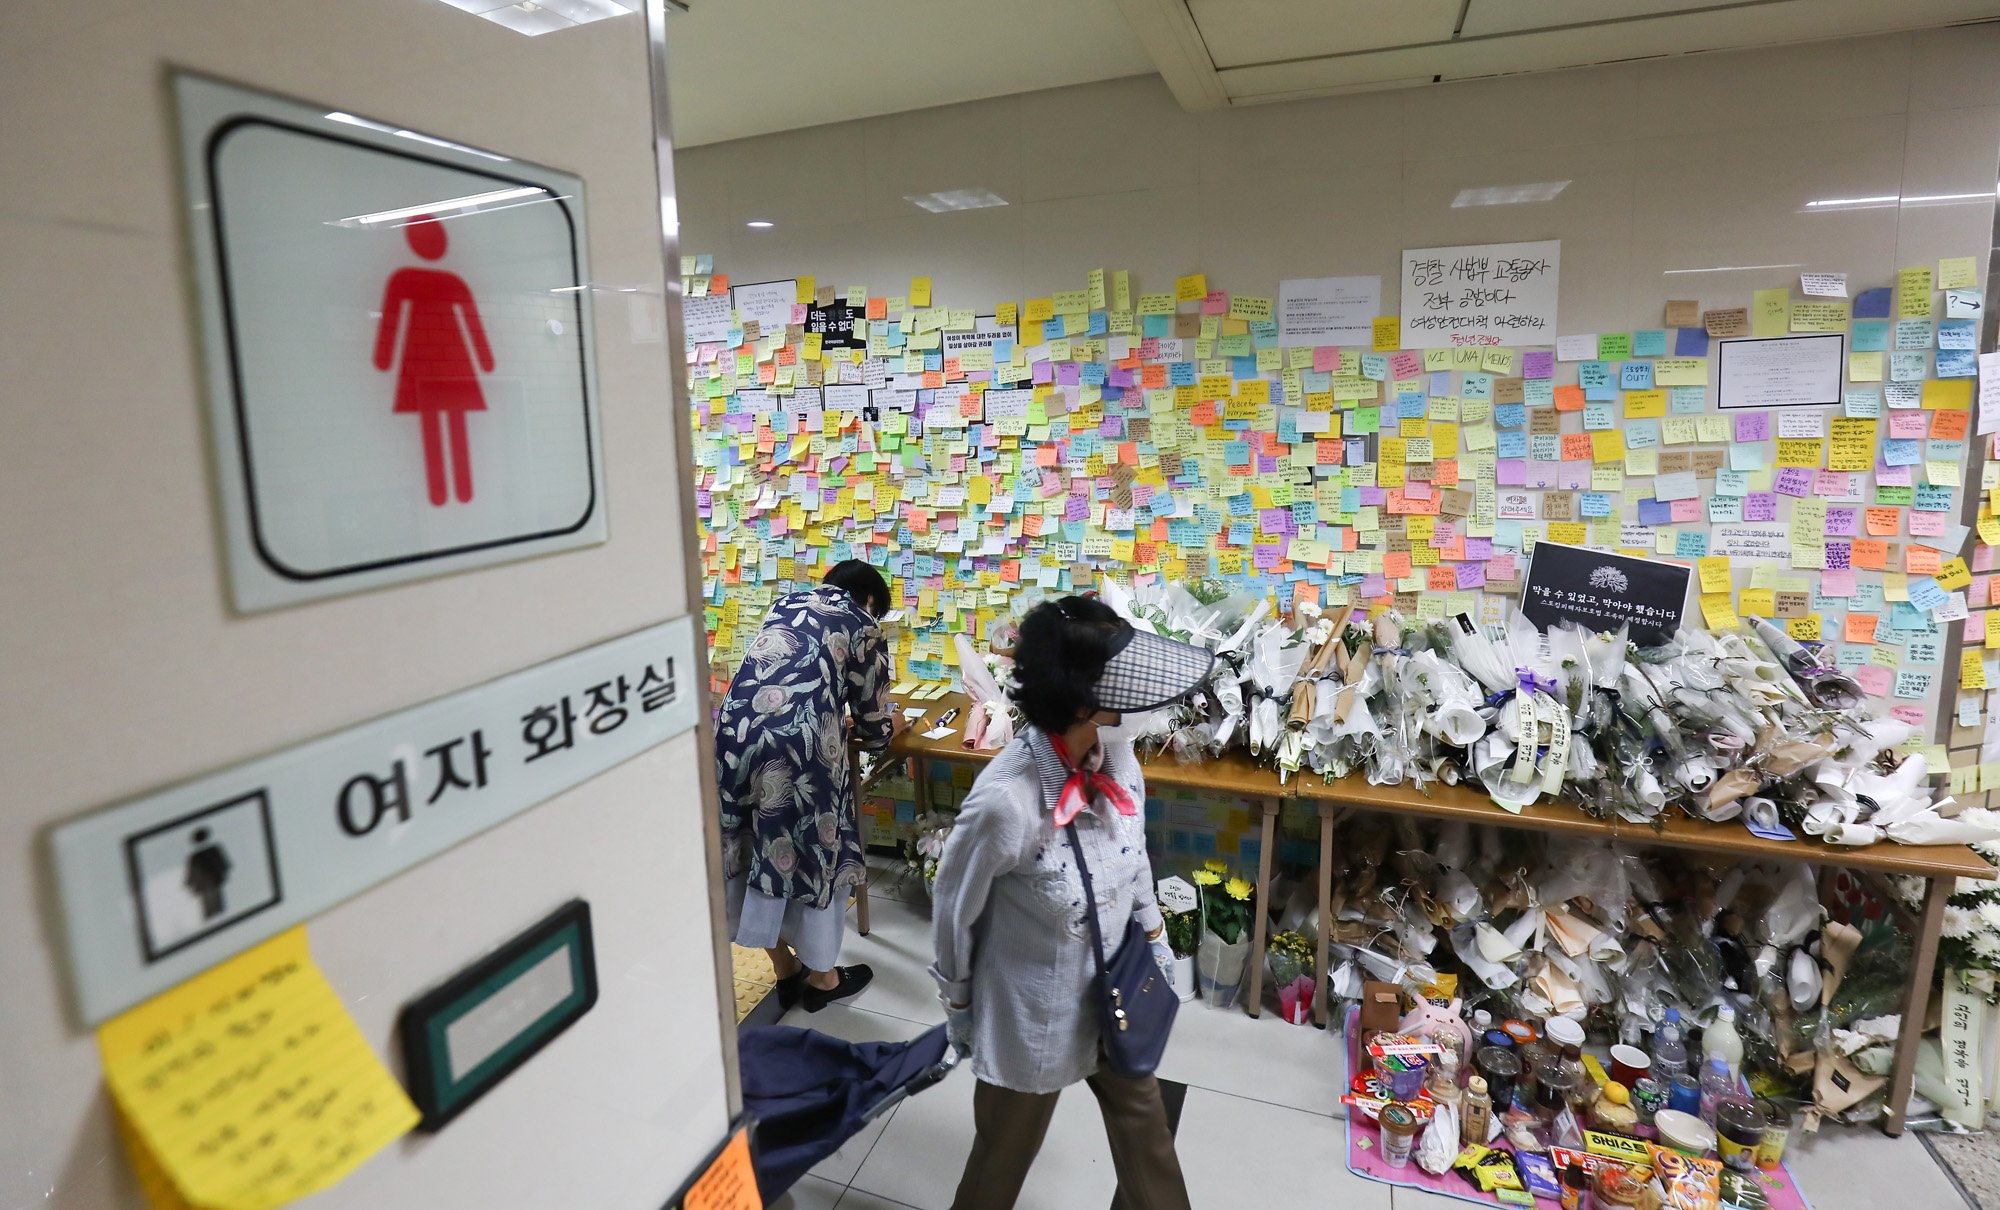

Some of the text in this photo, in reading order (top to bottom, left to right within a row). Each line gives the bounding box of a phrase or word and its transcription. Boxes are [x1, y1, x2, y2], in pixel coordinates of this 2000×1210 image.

[1410, 256, 1551, 286] 경찰 사법부 교통공사
[1424, 291, 1454, 310] 전부
[810, 310, 827, 321] 더는
[1411, 314, 1546, 330] 여성안전대책 마련하라
[811, 320, 855, 333] 잃을 수 없다
[963, 341, 977, 349] 살아갈
[987, 332, 1001, 340] 두려움
[1427, 350, 1512, 368] NI UNA MENOS
[1532, 585, 1676, 620] 막을 수 있었고, 막아야 했습니다
[1540, 599, 1602, 618] 스토킹피해자보호법
[1603, 611, 1625, 621] 조속히
[336, 657, 678, 838] 여자 화장실
[1591, 1134, 1649, 1155] 하비스트
